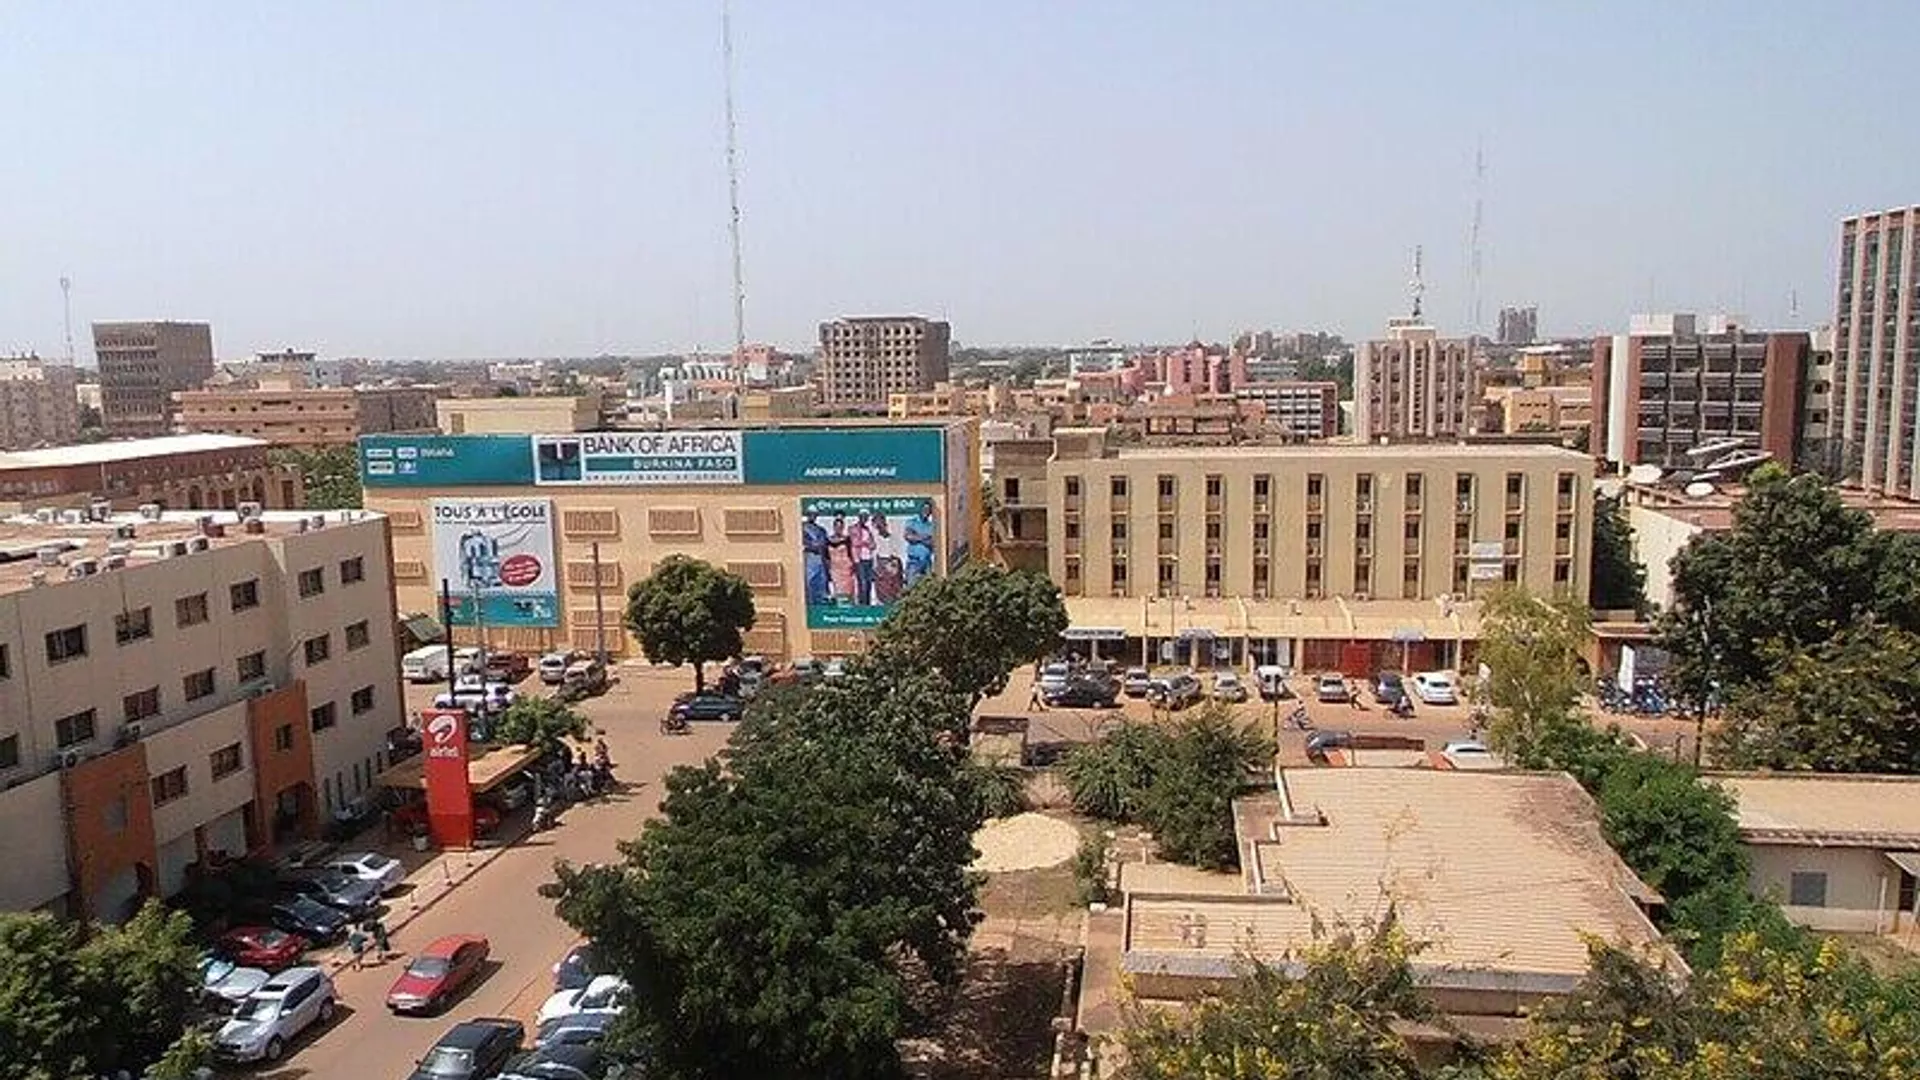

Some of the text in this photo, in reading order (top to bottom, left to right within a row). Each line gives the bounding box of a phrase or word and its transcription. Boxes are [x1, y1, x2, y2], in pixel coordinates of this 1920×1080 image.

[584, 435, 737, 455] BANK OF AFRICA
[633, 457, 734, 470] BURKINA FASO
[435, 505, 472, 519] TOUS
[430, 746, 459, 757] airtel
